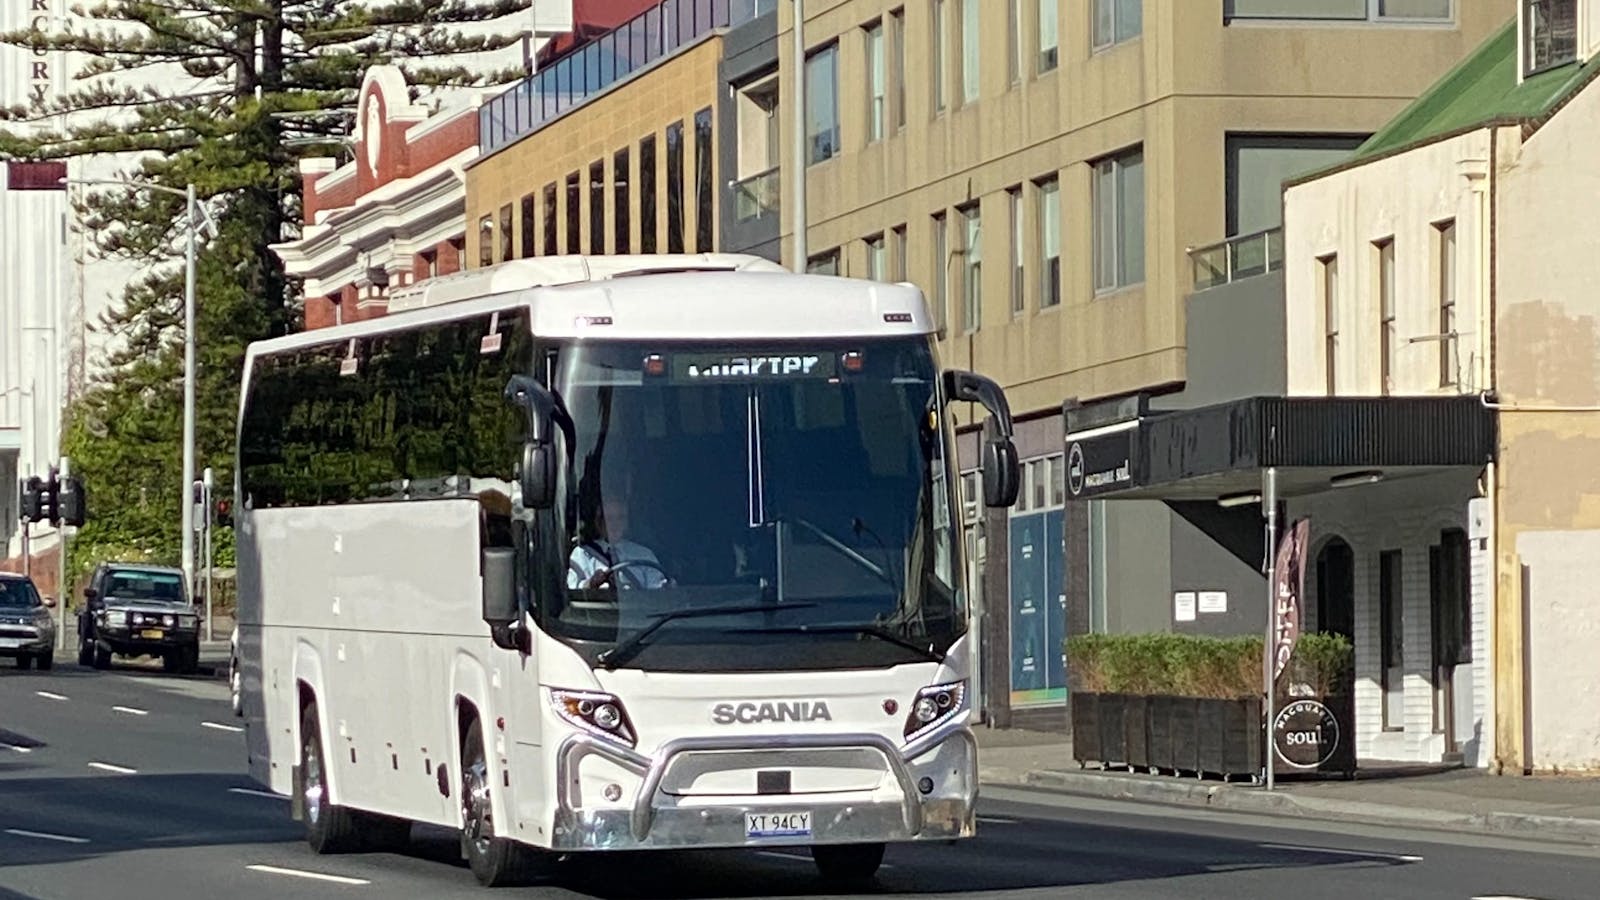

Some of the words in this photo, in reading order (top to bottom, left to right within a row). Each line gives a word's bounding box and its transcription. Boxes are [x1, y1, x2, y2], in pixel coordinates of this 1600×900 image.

[713, 702, 832, 724] SCANIA
[749, 815, 767, 832] XT
[771, 814, 808, 831] 94CY
